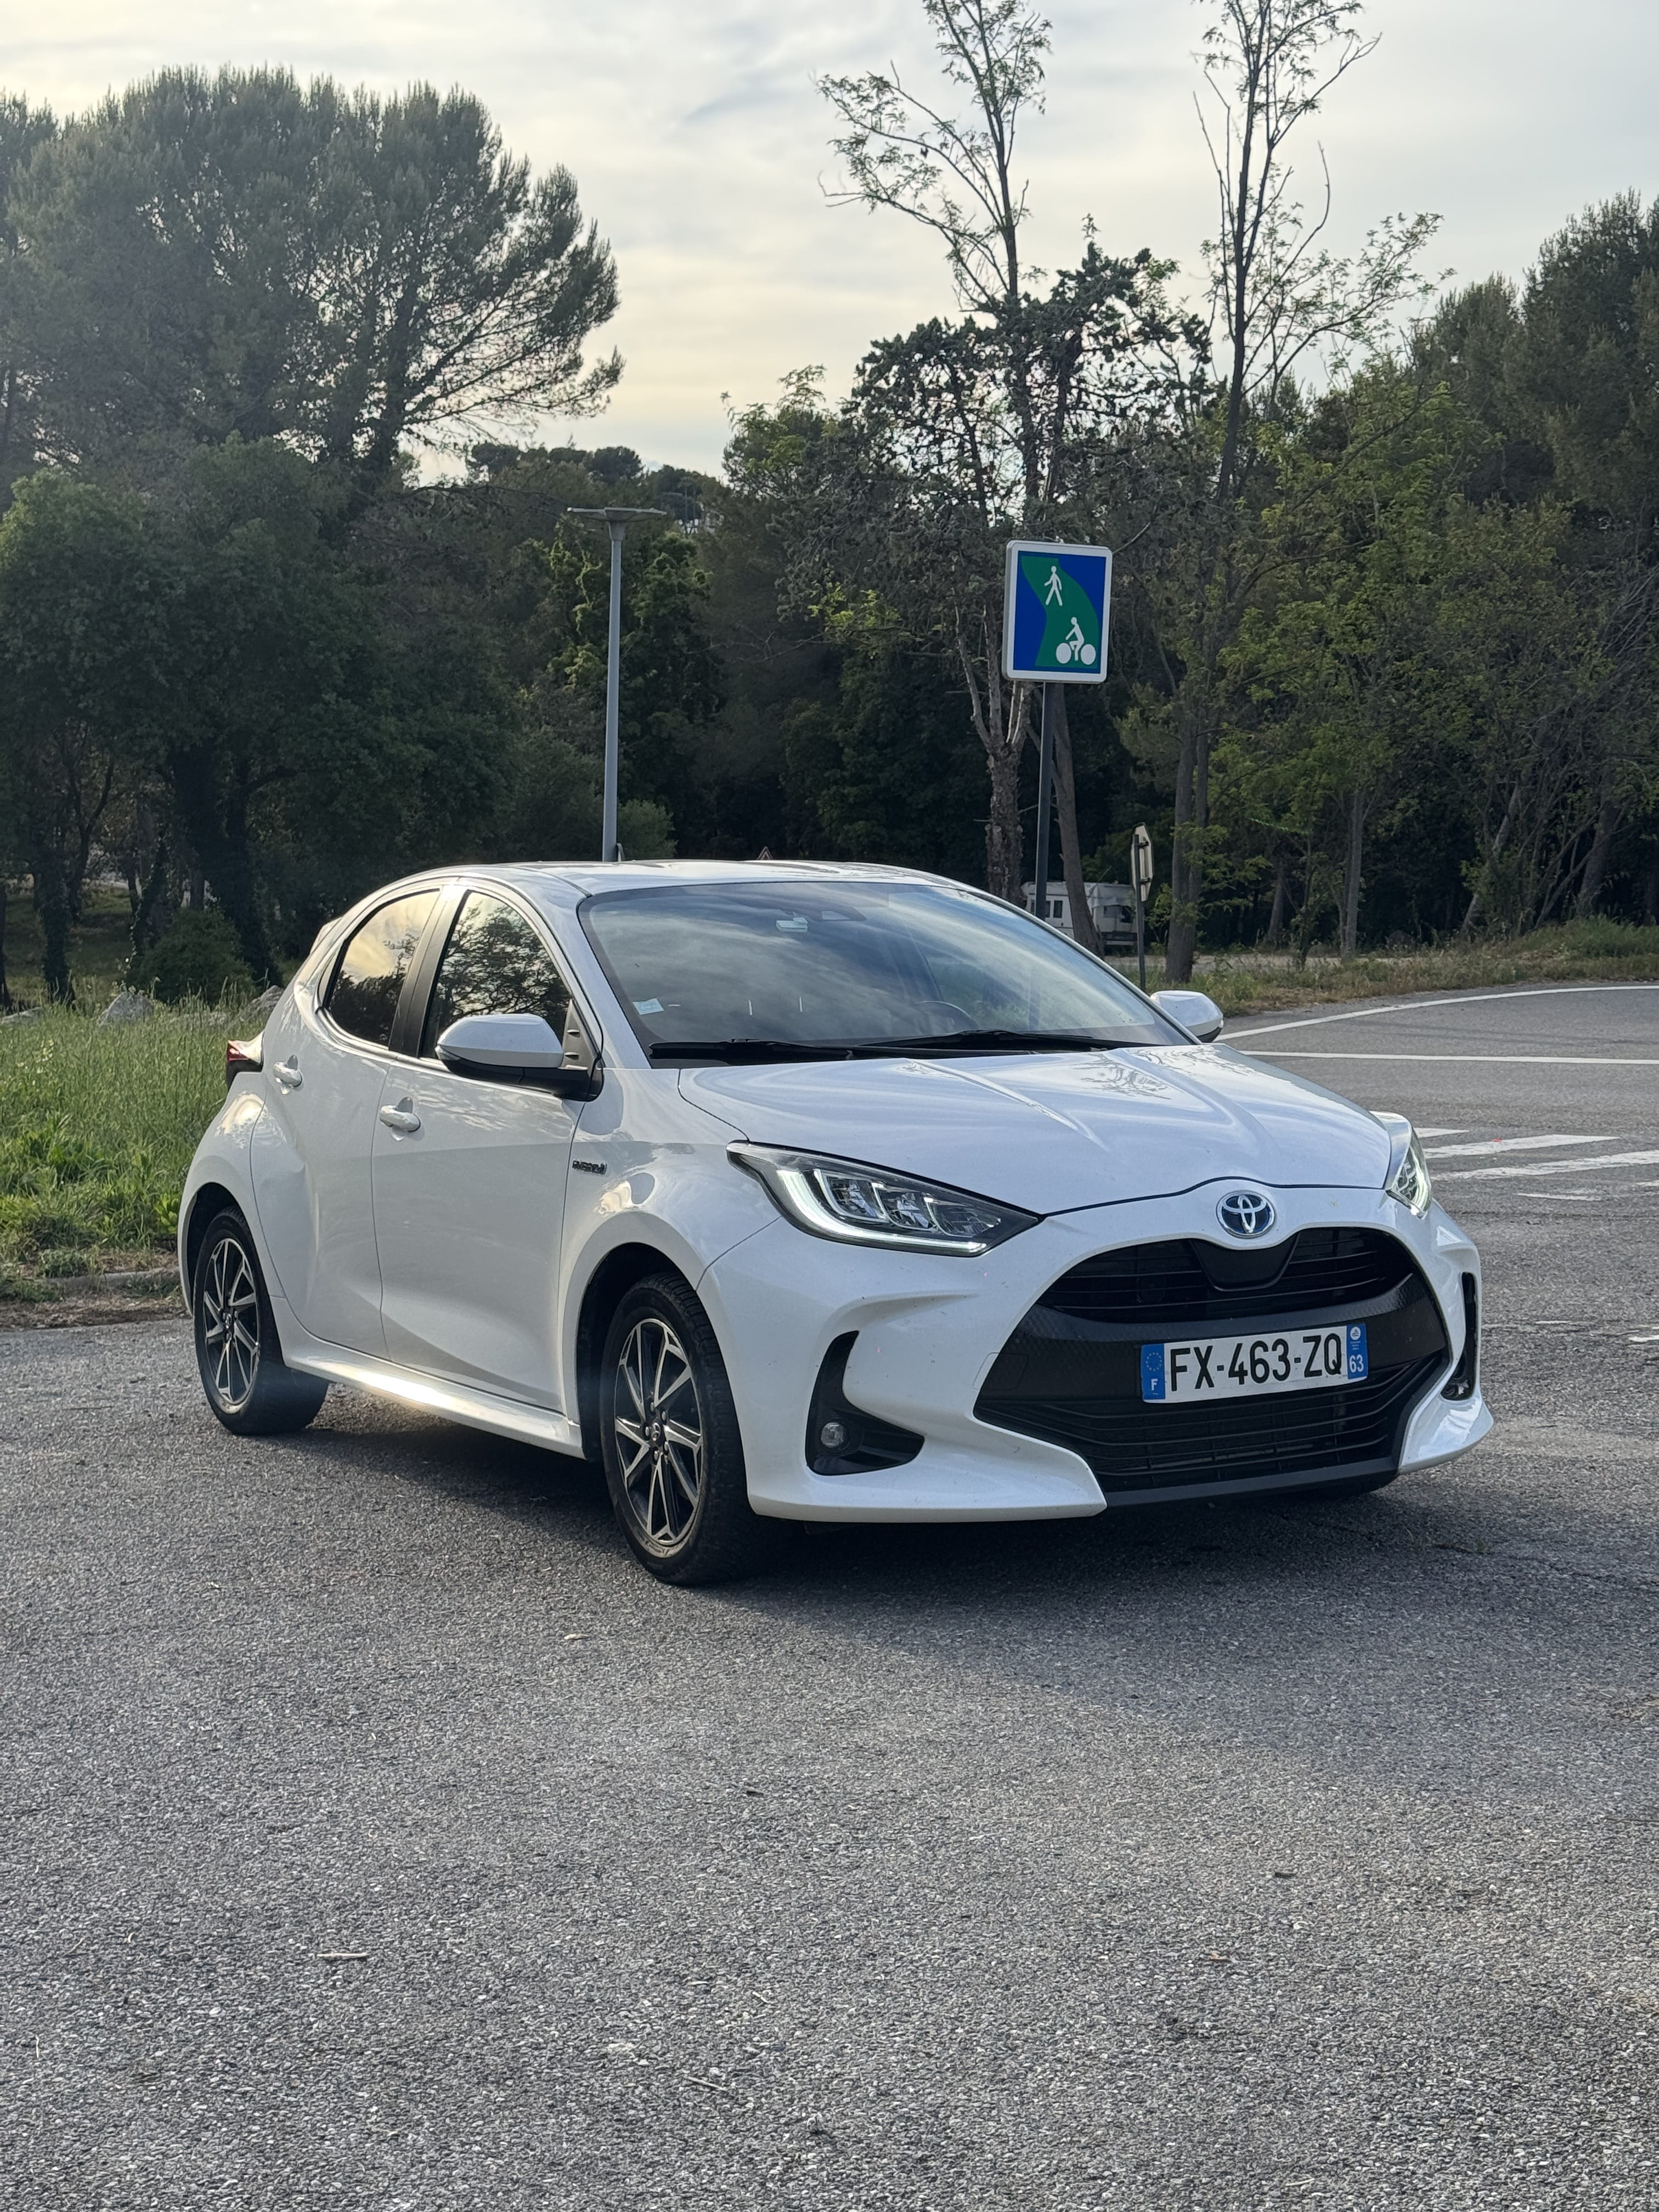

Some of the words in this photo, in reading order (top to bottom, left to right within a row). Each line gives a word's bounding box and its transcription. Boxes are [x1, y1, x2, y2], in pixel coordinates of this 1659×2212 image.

[1170, 1333, 1342, 1391] FX-463-ZQ
[1350, 1354, 1364, 1373] 63
[1151, 1378, 1158, 1391] F
